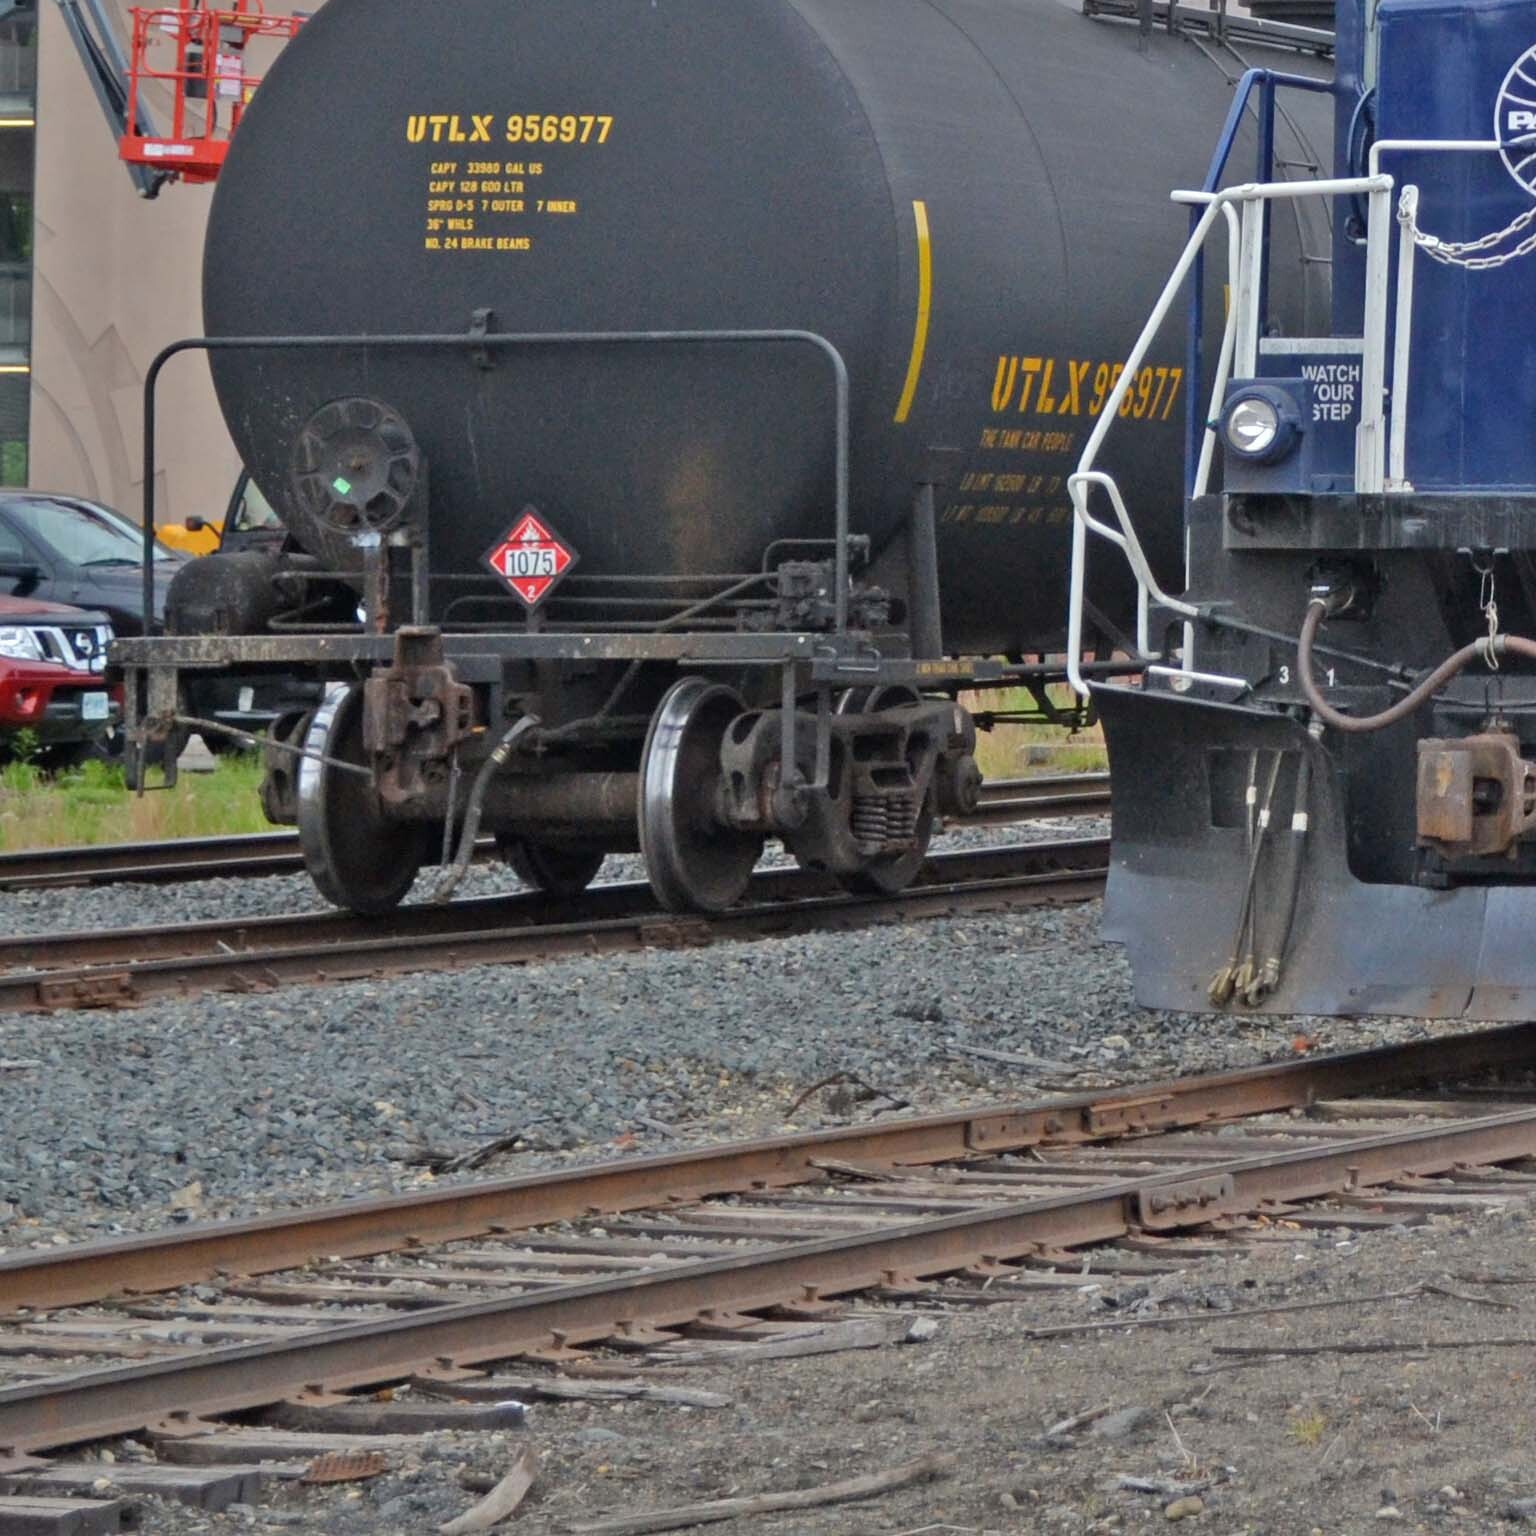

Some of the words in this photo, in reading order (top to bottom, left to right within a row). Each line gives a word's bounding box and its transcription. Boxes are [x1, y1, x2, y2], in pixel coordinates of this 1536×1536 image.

[406, 115, 493, 142] UTLX
[506, 115, 612, 143] 956977
[431, 162, 457, 174] CAPY
[505, 162, 525, 174] GAL
[528, 162, 543, 174] US
[429, 181, 456, 193] CAPY
[504, 181, 524, 193] LTR
[481, 200, 488, 212] 7
[491, 200, 524, 212] OUTER
[536, 201, 544, 213] 7
[444, 237, 458, 249] 24
[461, 237, 494, 249] BRAKE
[497, 237, 530, 249] BEAMS
[1301, 365, 1359, 382] WATCH
[991, 356, 1090, 415] UTLX
[509, 551, 553, 575] 1075
[527, 585, 536, 598] 2
[1279, 665, 1290, 684] 3
[1326, 668, 1335, 687] 1
